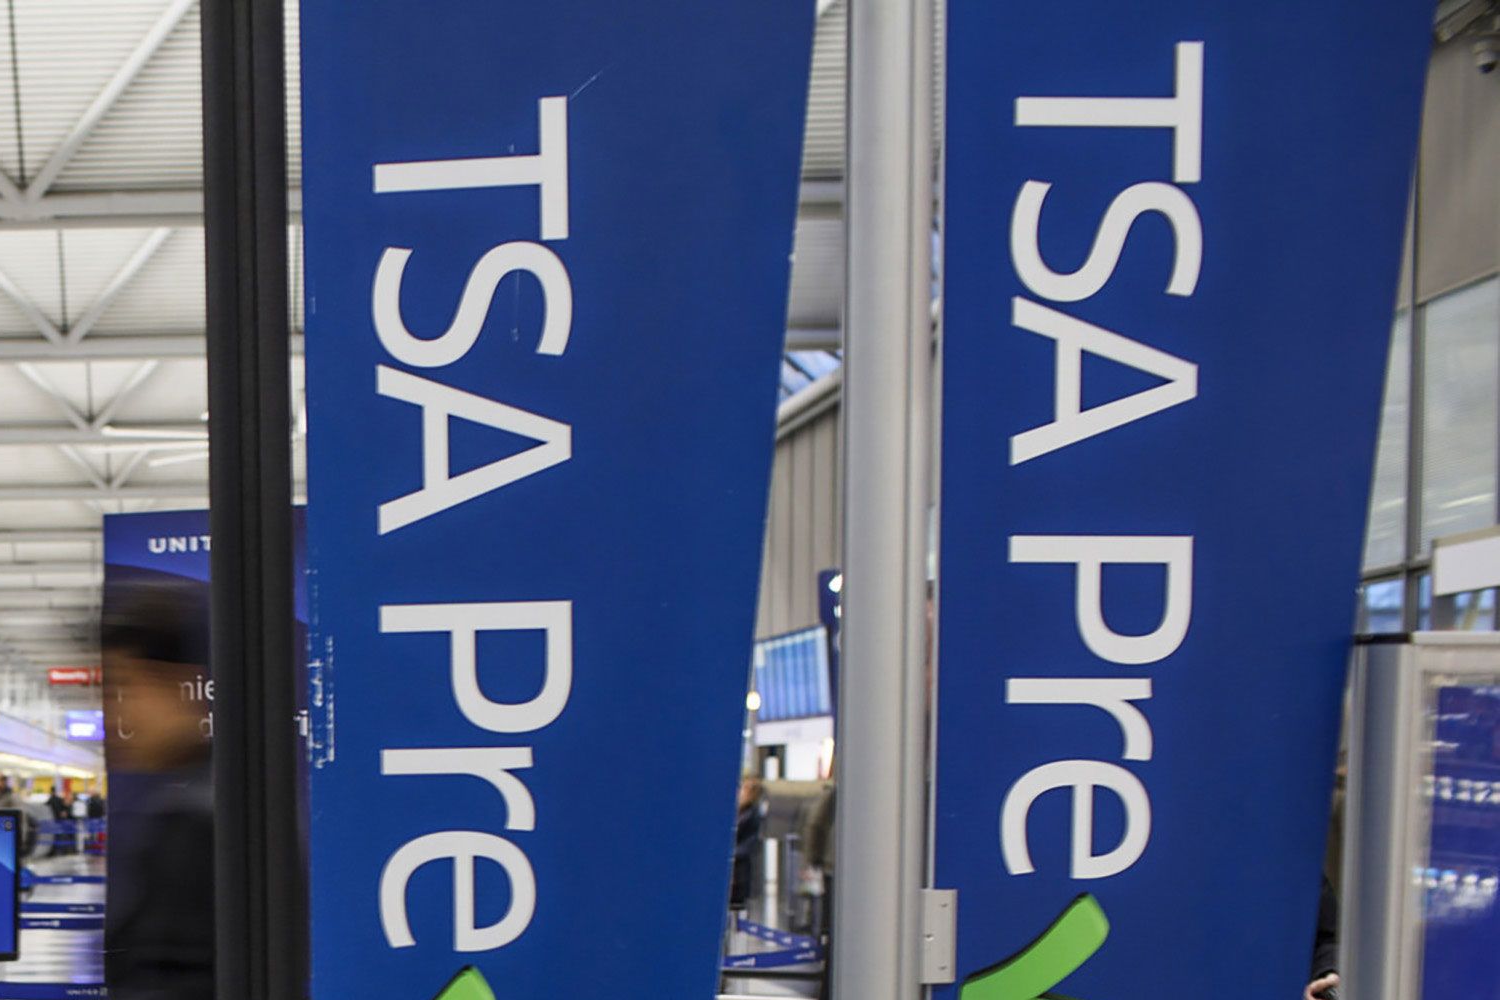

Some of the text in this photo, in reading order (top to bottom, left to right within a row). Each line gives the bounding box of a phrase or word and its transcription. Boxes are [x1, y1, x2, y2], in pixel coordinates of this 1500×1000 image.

[372, 96, 573, 953] TSA Pre
[1001, 41, 1204, 880] TSA Pre
